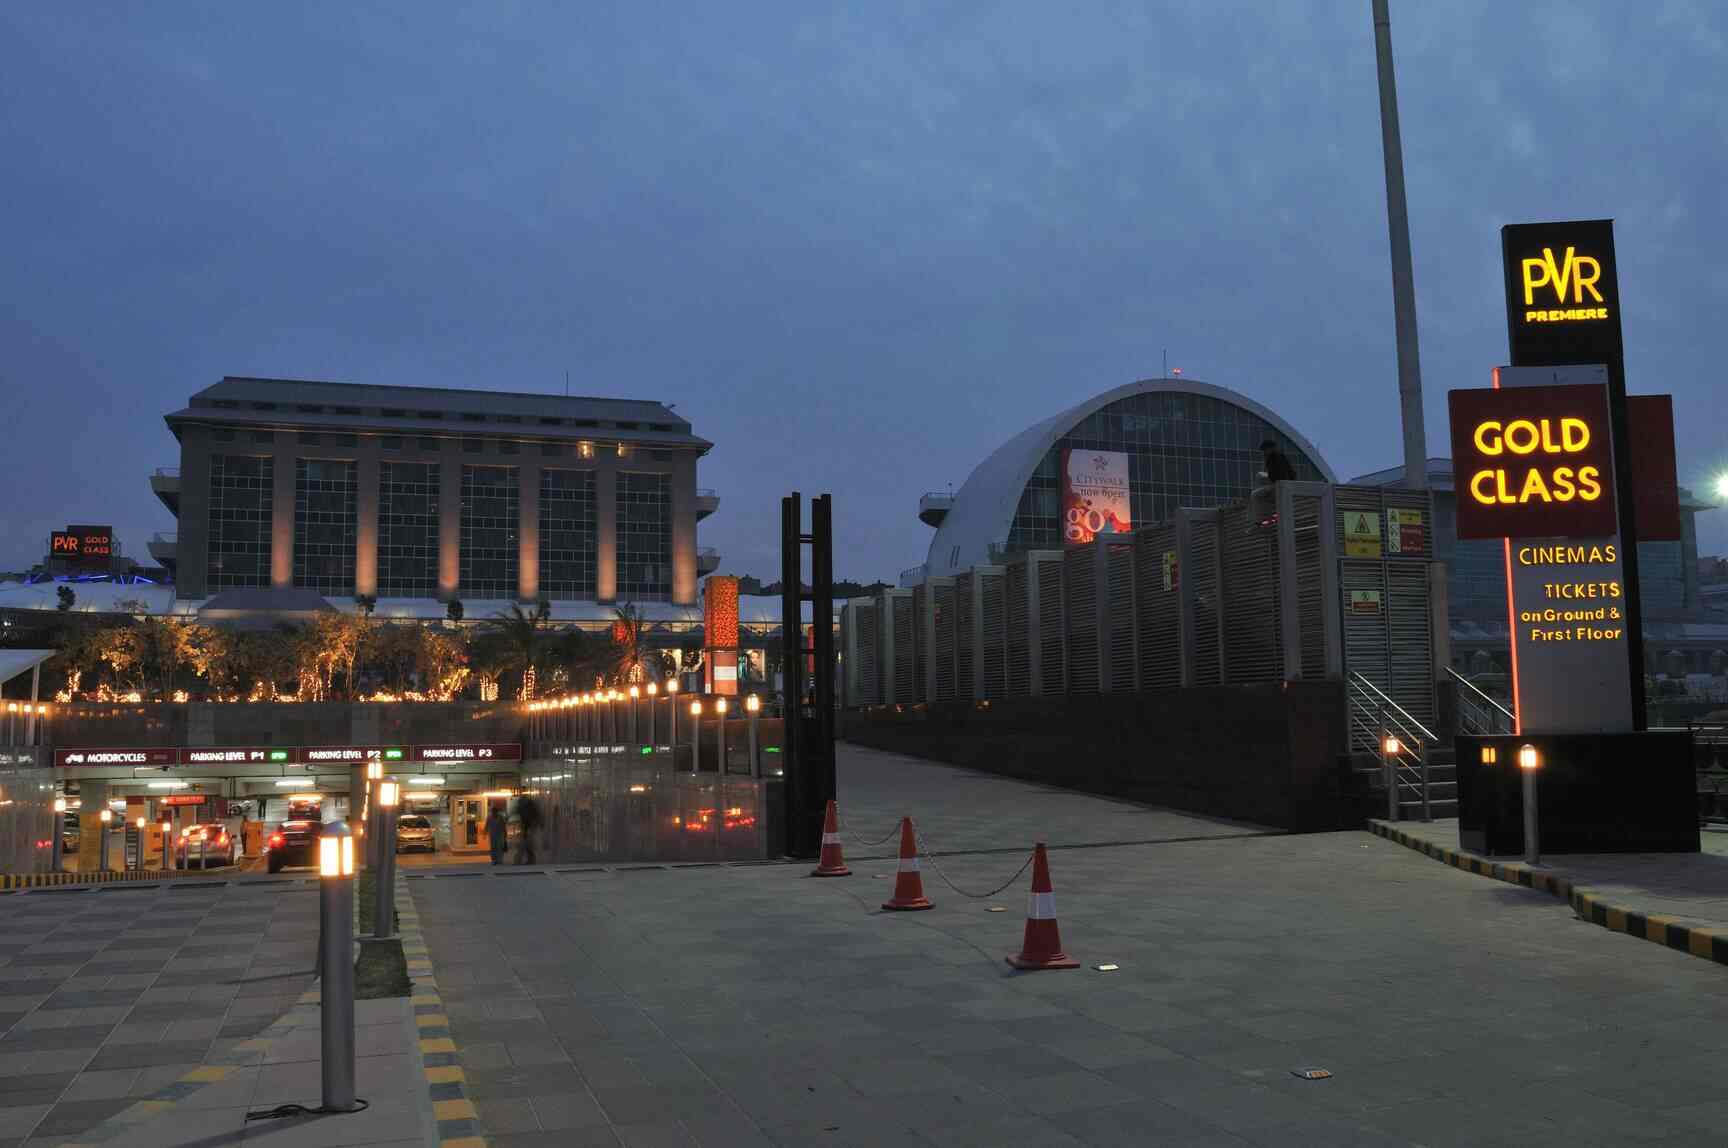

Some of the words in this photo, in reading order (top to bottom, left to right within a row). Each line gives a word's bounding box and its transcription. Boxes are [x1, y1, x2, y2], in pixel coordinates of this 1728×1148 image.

[1521, 246, 1604, 305] PVR
[1526, 307, 1608, 322] PREMIERE
[1473, 418, 1590, 456] GOLD
[1470, 466, 1601, 505] CLASS
[54, 535, 78, 551] PVR
[85, 536, 109, 544] GOLD
[1519, 545, 1617, 565] CINEMAS
[1545, 582, 1621, 599] TICKETS
[1521, 611, 1541, 622] on
[1544, 607, 1605, 622] Ground
[1609, 607, 1621, 619] &
[1531, 629, 1571, 641] First
[1577, 628, 1621, 641] Floor
[87, 753, 146, 762] MOTORCYCLES
[190, 751, 225, 761] PARKING
[225, 751, 246, 761] LEVEL
[309, 750, 342, 760] PARKING
[343, 750, 362, 759] LEVEL
[367, 750, 381, 759] P2
[423, 749, 454, 758] PARKING
[455, 749, 474, 758] LEVEL
[479, 749, 493, 757] P3
